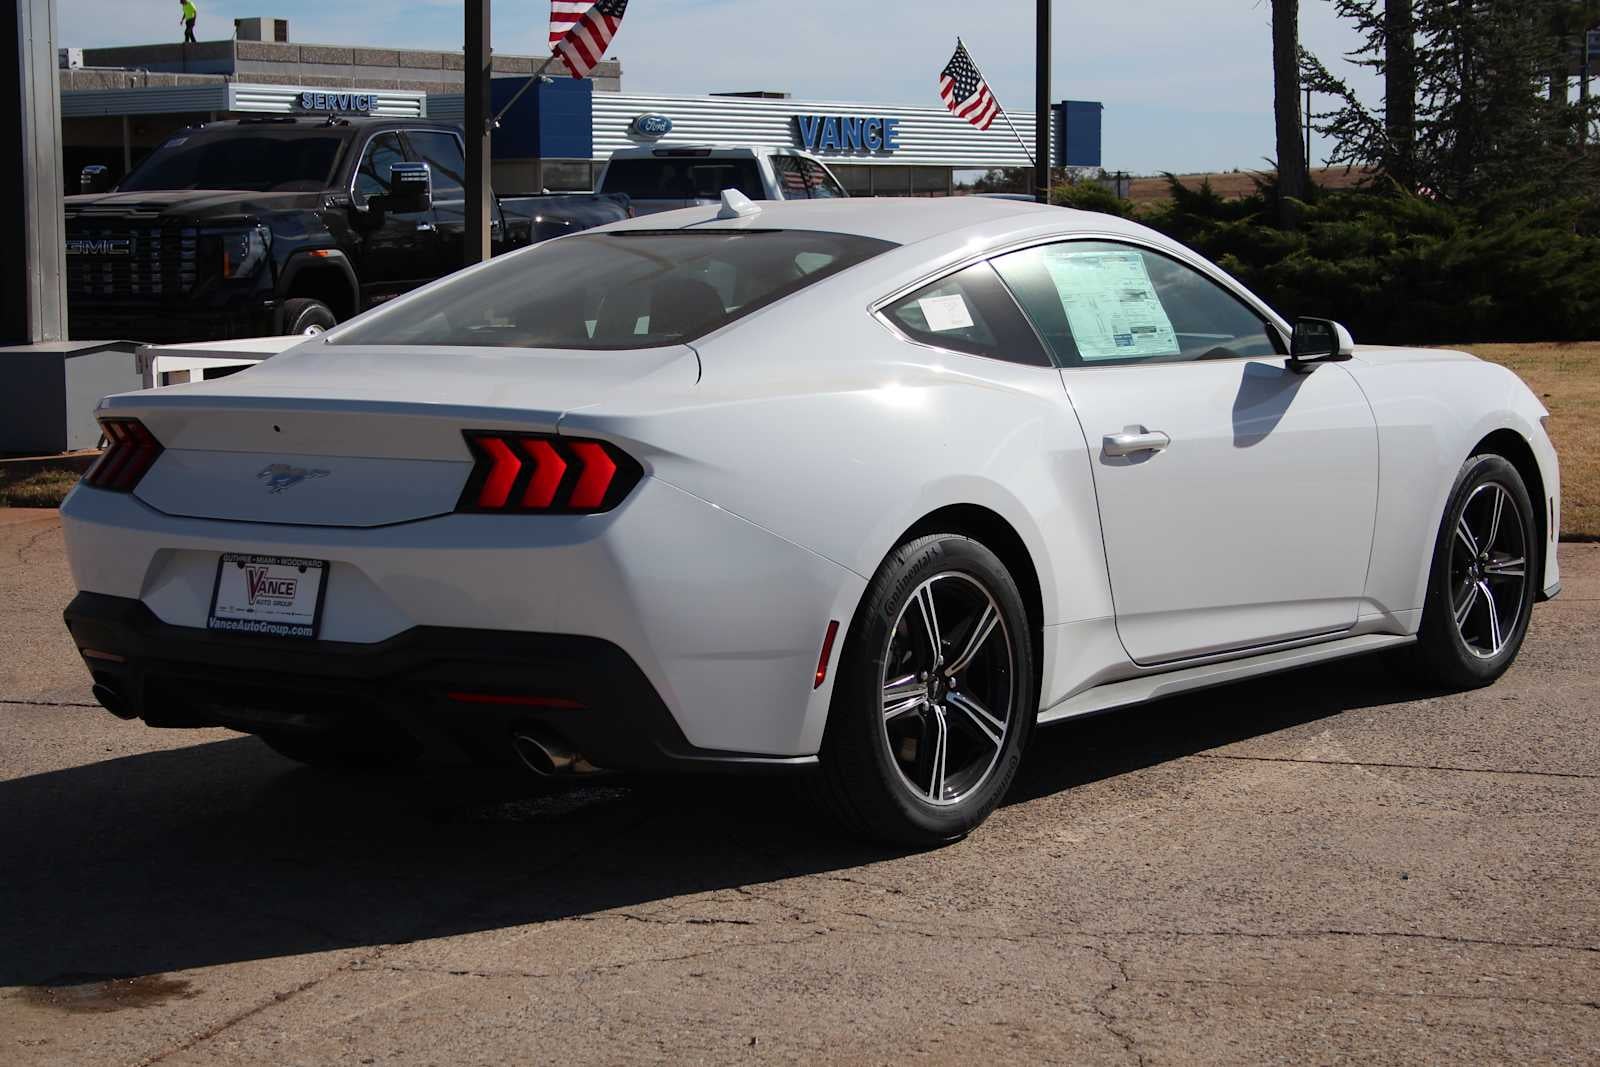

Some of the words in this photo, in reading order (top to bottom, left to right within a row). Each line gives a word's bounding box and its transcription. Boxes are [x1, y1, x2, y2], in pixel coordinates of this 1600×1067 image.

[302, 92, 378, 111] SERVICE
[645, 117, 668, 132] Ford
[796, 115, 900, 151] VANCE
[209, 616, 313, 637] VanceAutoGroup.com
